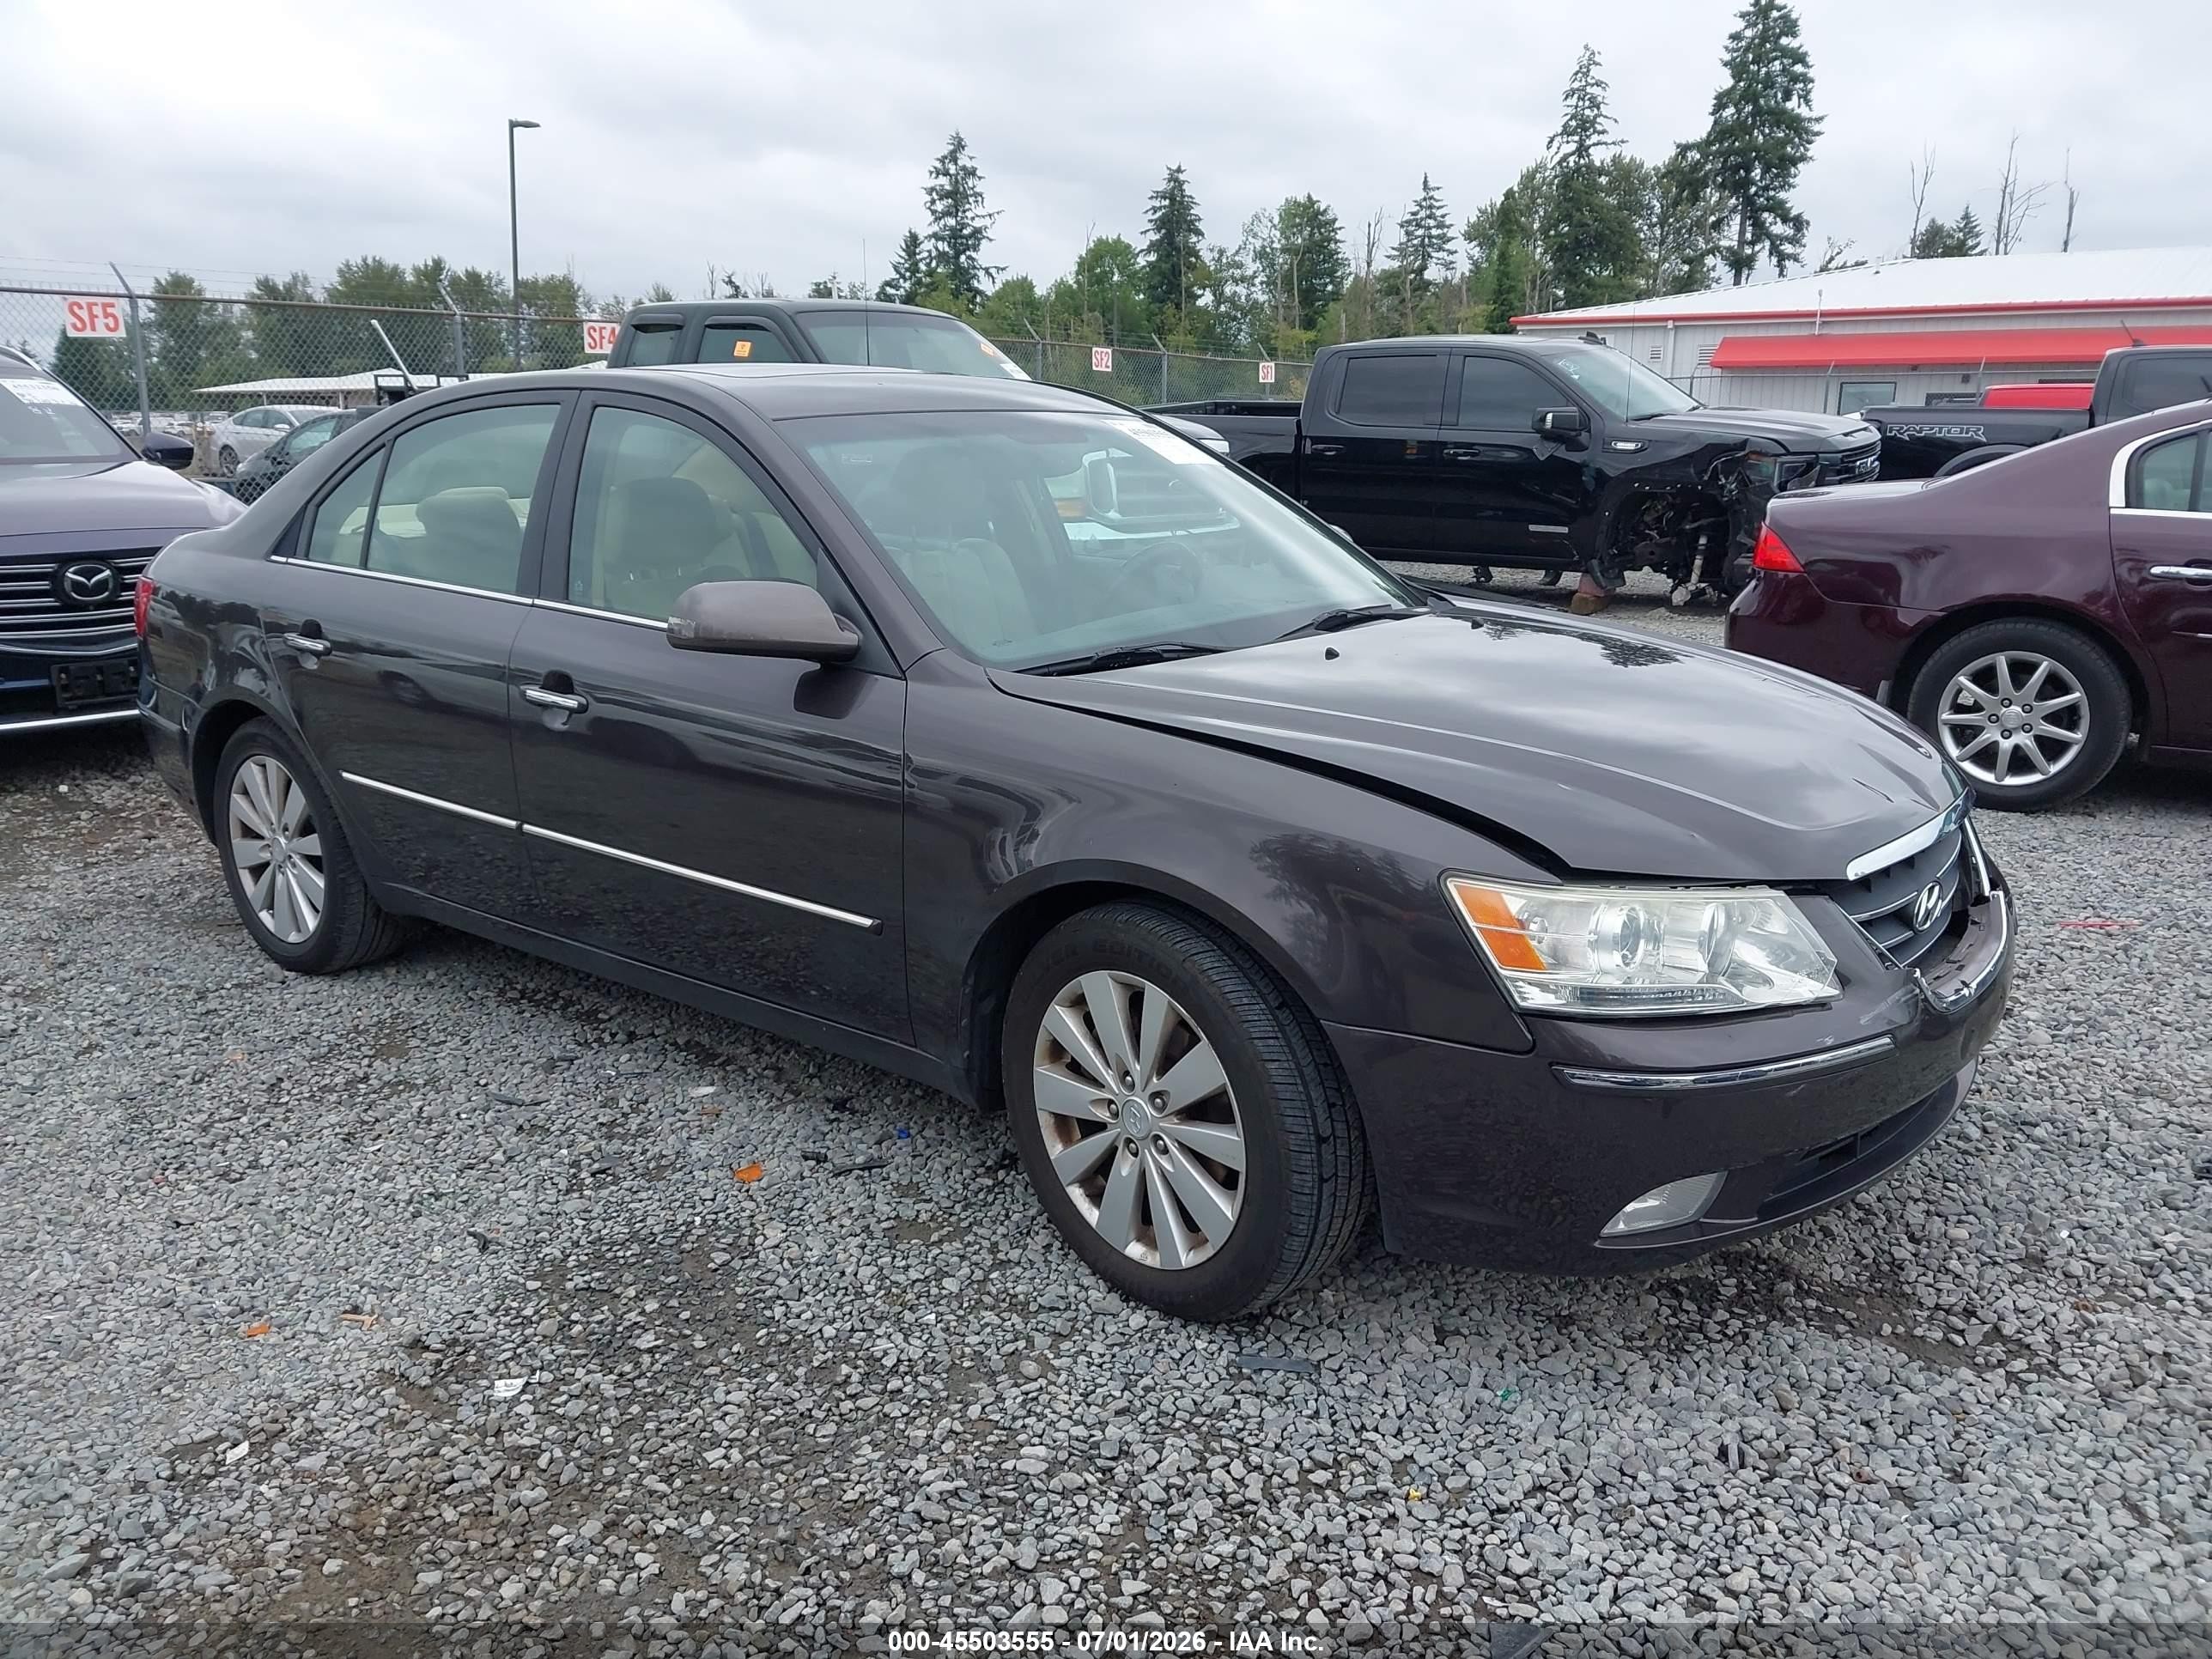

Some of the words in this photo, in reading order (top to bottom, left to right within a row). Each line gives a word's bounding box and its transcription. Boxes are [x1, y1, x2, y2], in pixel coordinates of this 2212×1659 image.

[68, 301, 119, 333] SF5
[587, 325, 617, 349] SF4
[1094, 349, 1110, 368] SF2
[1261, 364, 1273, 380] SF1
[1887, 424, 1987, 442] RAPTOR
